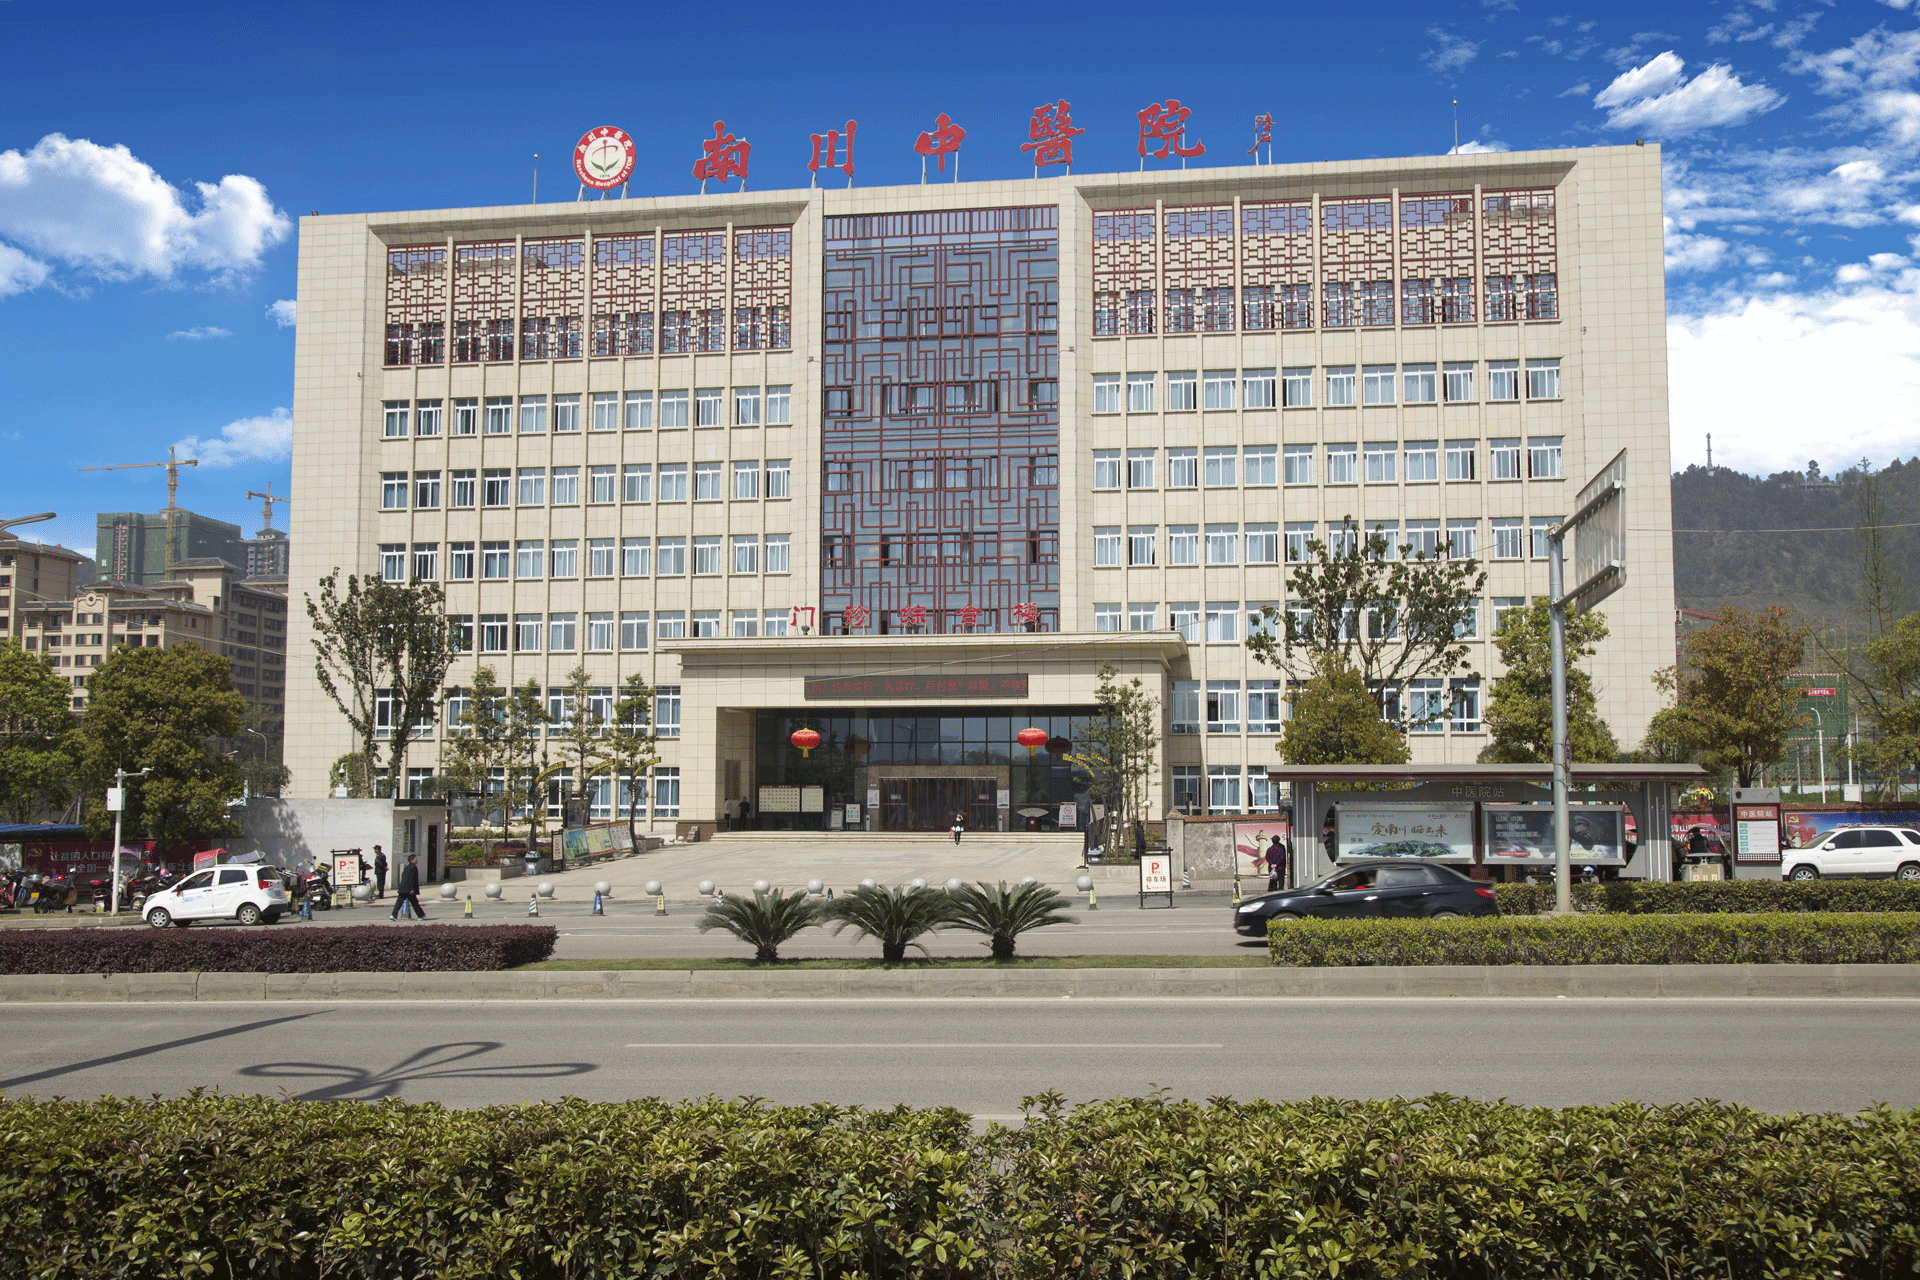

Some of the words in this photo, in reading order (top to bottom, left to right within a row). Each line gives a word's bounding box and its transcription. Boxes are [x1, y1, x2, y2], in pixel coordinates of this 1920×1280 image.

[692, 98, 1206, 184] 南川中醫院
[595, 175, 621, 187] Hospital
[790, 602, 1041, 628] 门诊综合楼
[1451, 785, 1505, 798] 中医院站
[1740, 810, 1773, 818] 中医院站
[1151, 862, 1160, 874] P
